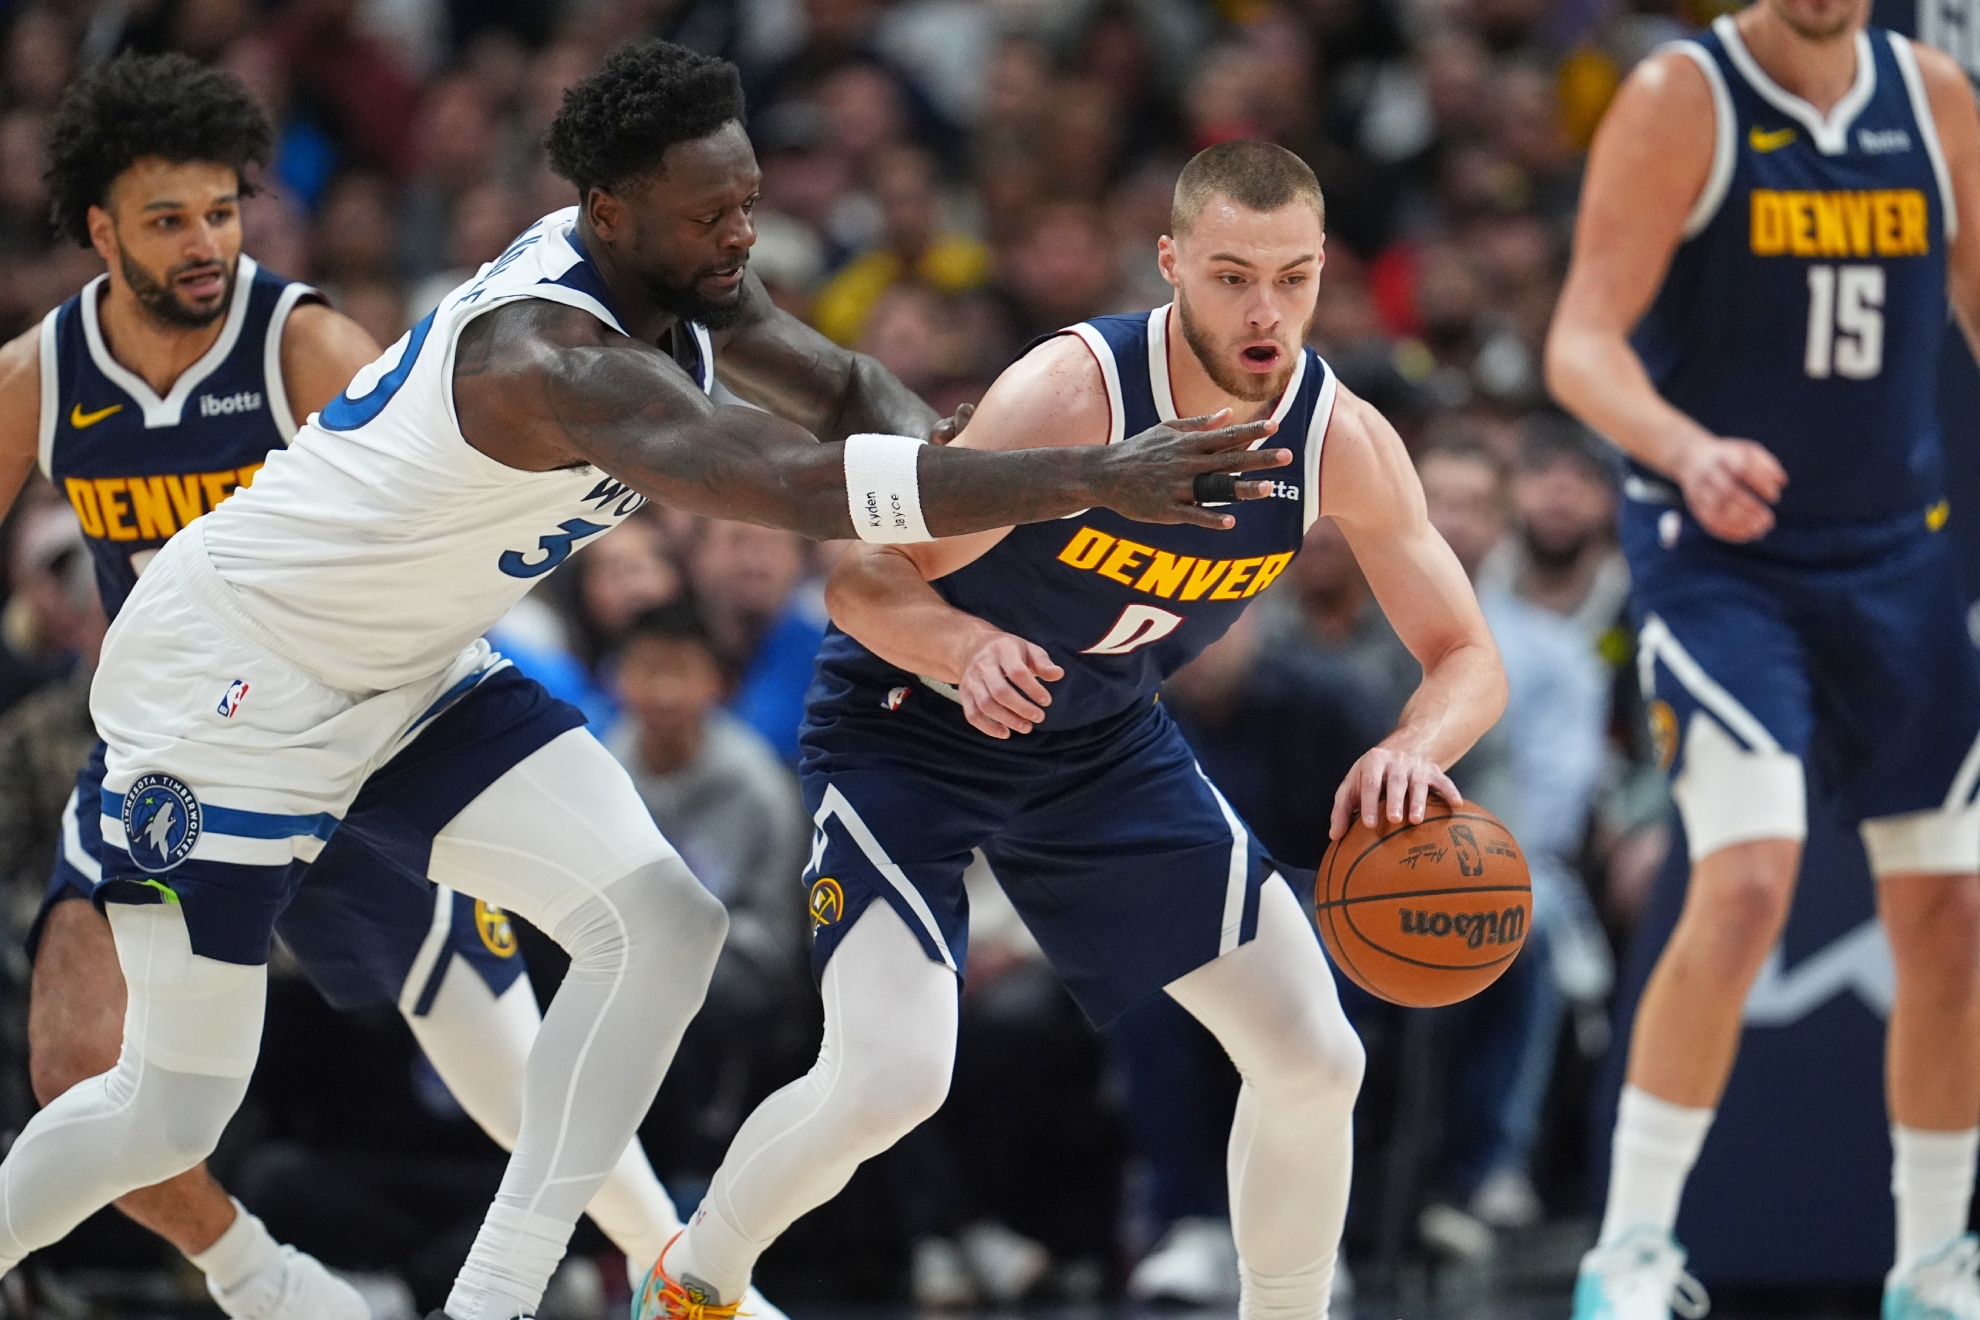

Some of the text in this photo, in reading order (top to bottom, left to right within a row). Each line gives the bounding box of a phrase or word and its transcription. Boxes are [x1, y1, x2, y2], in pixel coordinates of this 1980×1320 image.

[1751, 189, 1928, 256] DENVER
[1804, 265, 1886, 379] 15
[865, 491, 882, 528] Kyden
[891, 493, 908, 529] Jayce
[1056, 525, 1297, 601] DENVER
[124, 776, 198, 857] MINNESOTA TIMBERWOLVES
[1399, 904, 1525, 949] Wilson
